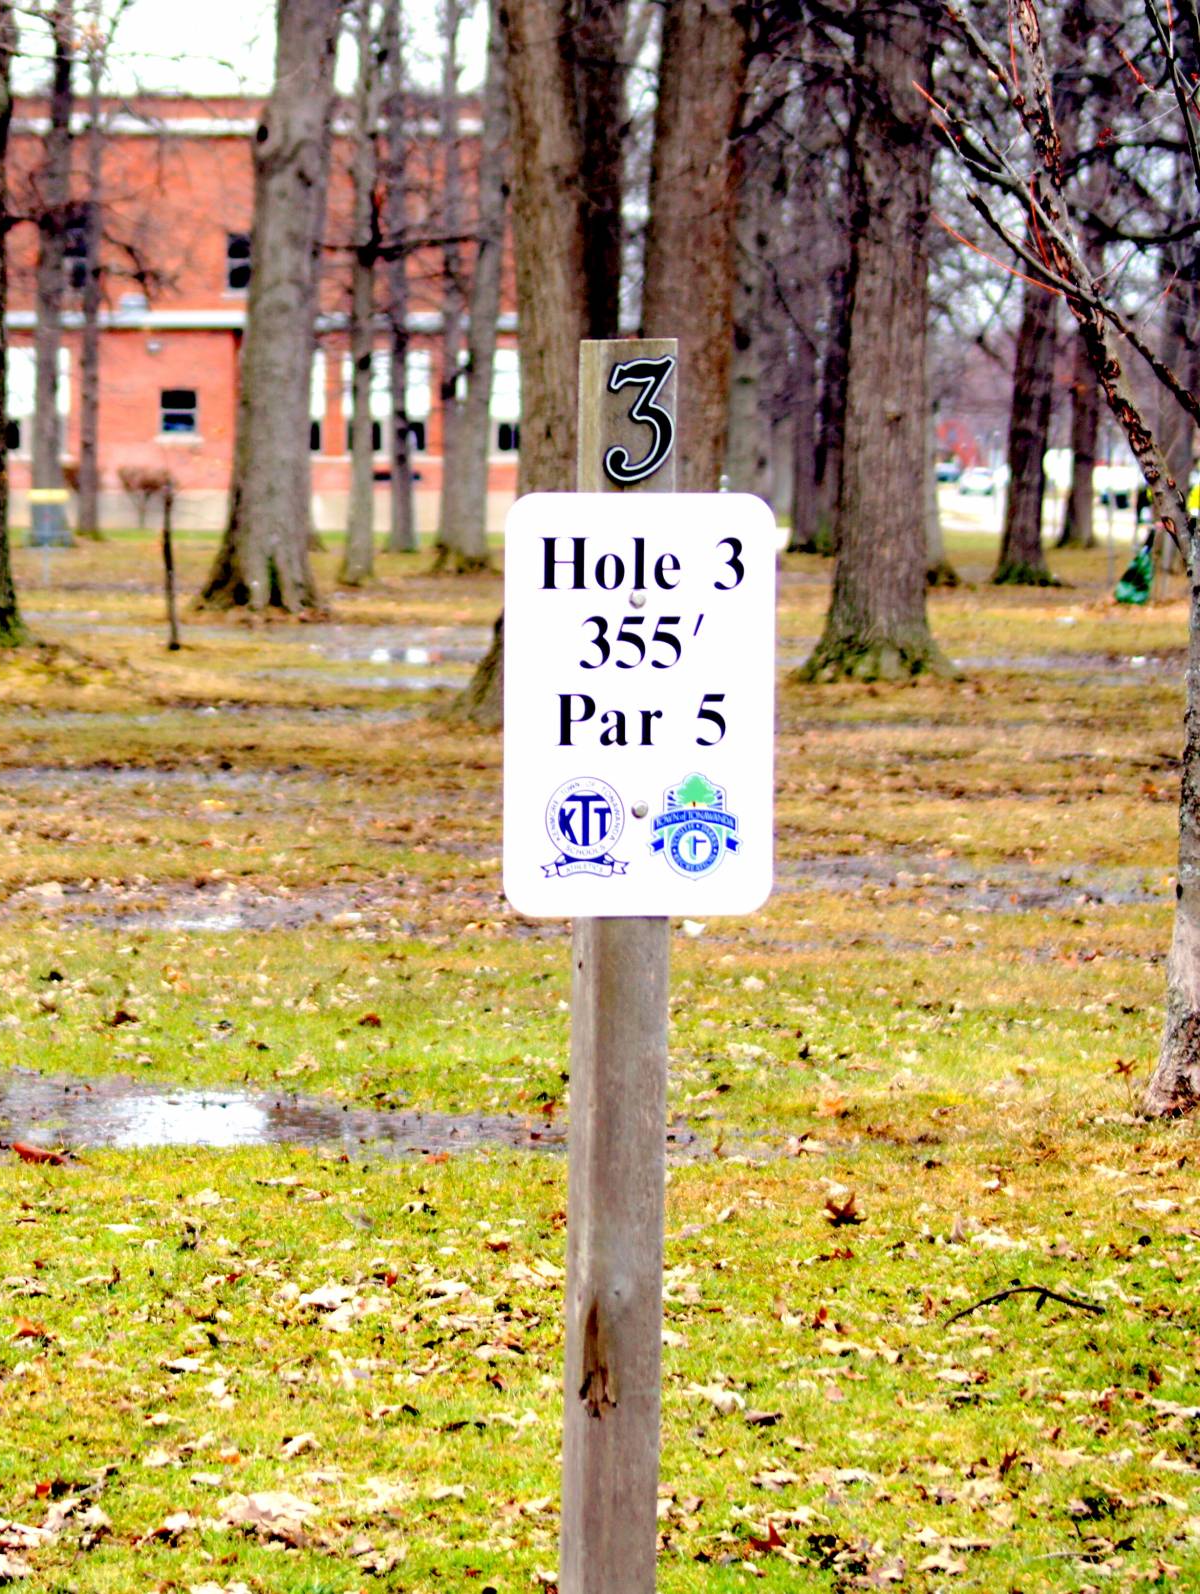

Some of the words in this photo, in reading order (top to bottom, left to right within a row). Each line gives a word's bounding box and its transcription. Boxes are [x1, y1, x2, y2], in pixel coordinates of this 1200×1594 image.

[603, 354, 676, 487] 3
[542, 537, 681, 590] Hole
[714, 537, 745, 591] 3
[558, 694, 663, 747] Par
[696, 694, 726, 746] 5
